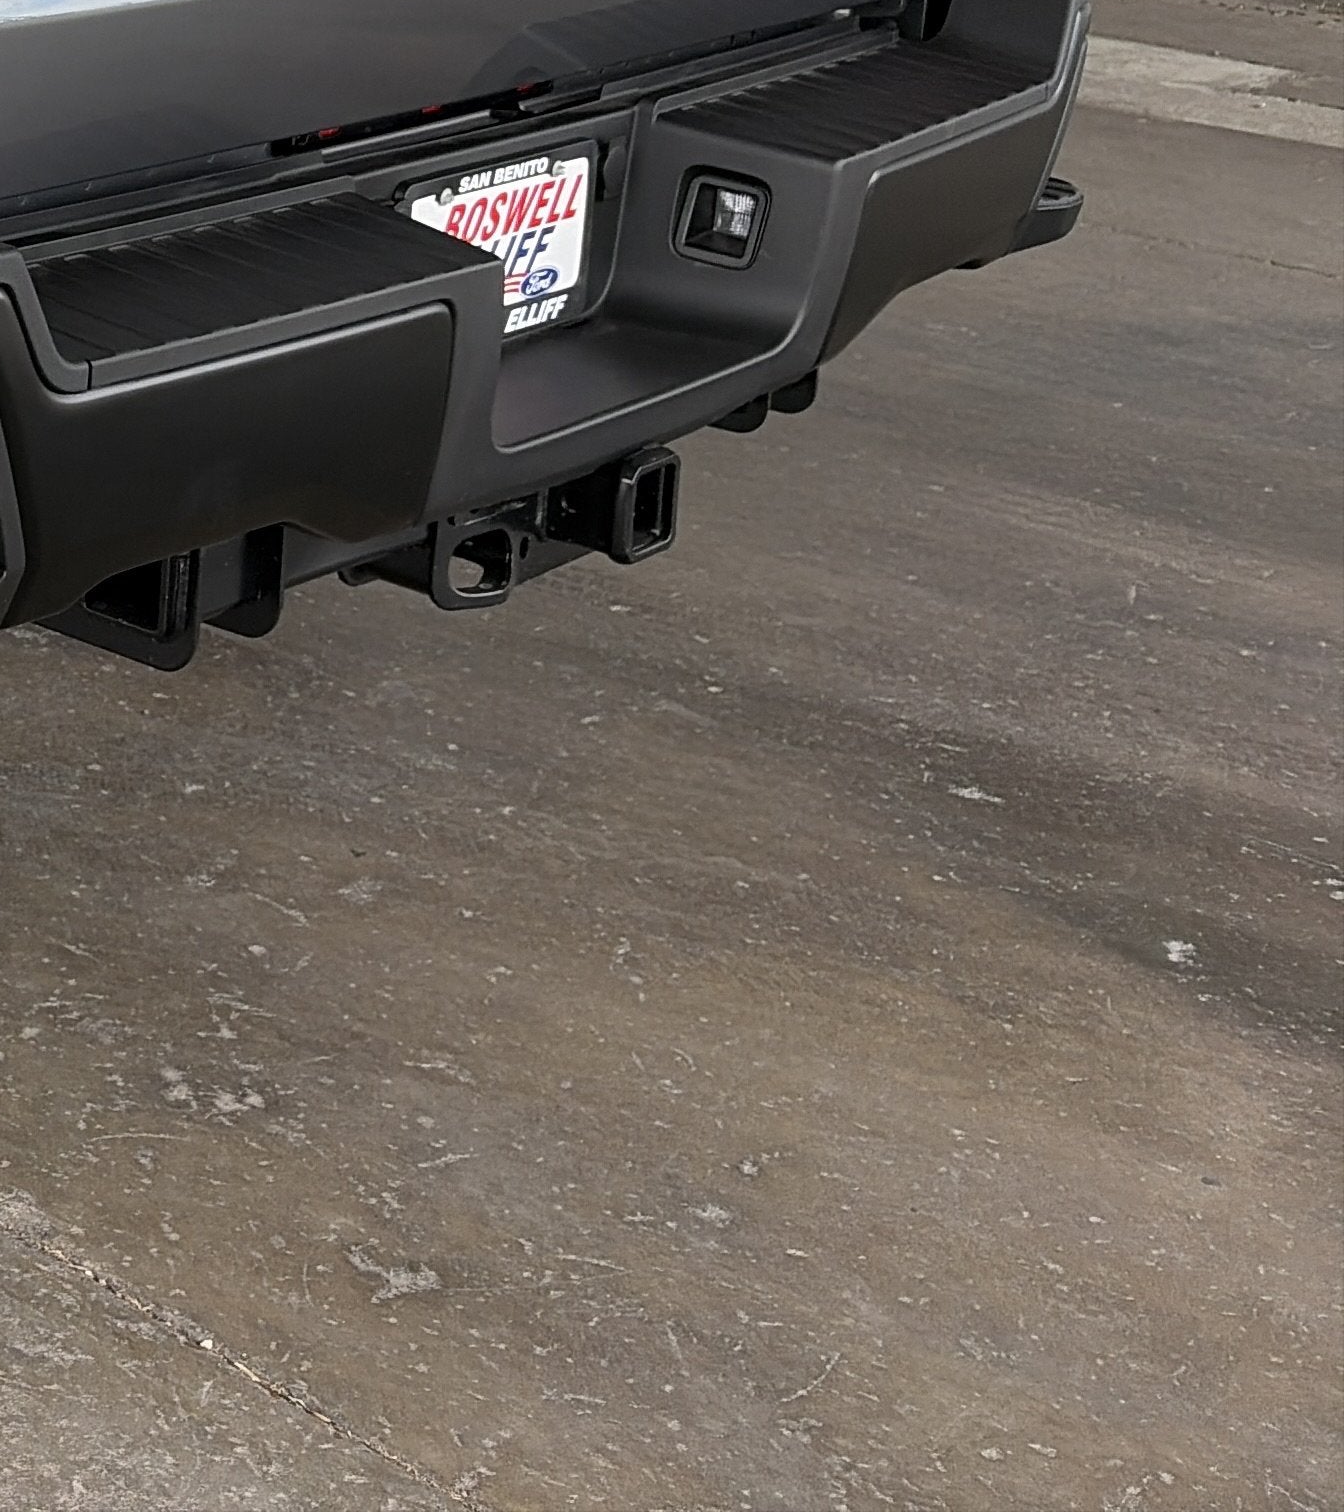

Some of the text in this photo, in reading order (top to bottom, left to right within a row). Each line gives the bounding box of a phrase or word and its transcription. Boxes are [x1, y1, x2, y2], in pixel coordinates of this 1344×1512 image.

[459, 157, 549, 193] SAN BENITO
[445, 174, 583, 244] BOSWELL
[503, 294, 568, 333] ELLIFF
